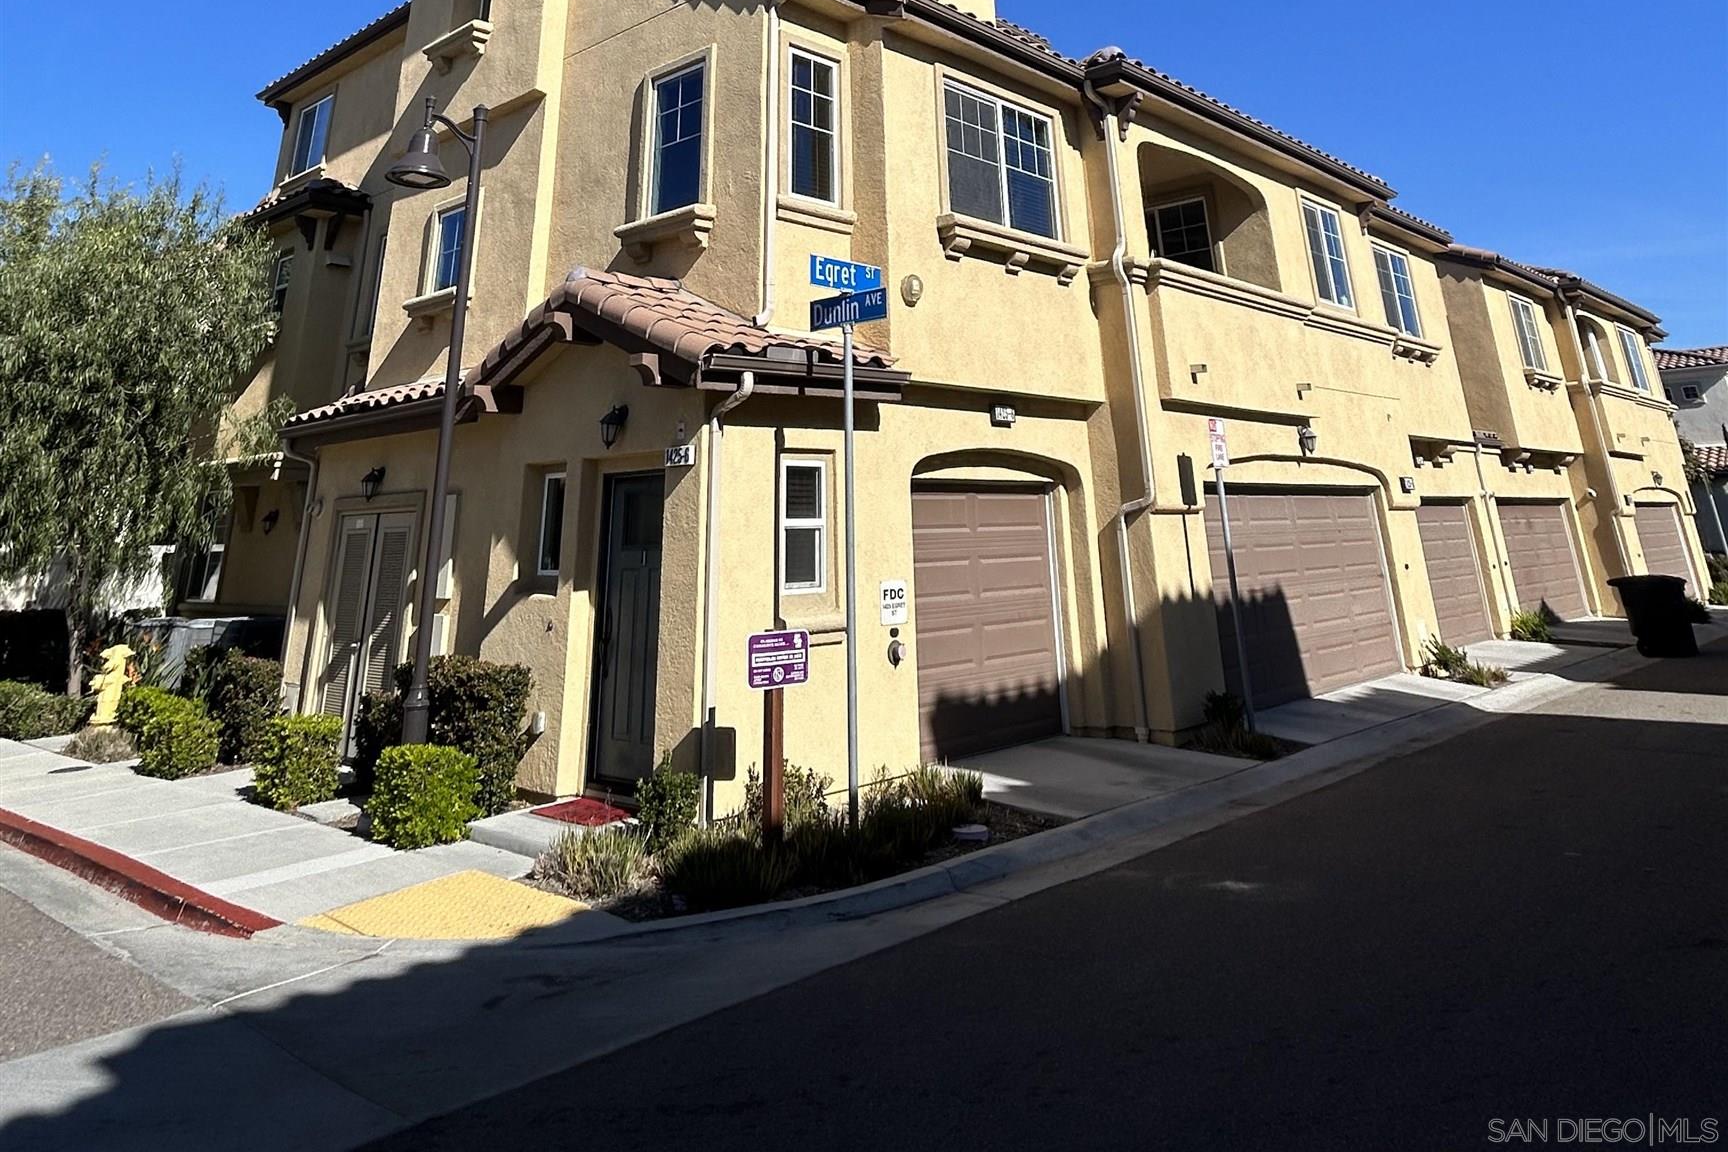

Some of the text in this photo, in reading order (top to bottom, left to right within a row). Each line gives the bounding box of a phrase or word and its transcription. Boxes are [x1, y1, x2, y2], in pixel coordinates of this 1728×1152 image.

[815, 256, 876, 286] Egret ST
[813, 292, 883, 327] Dunlin AVE
[883, 587, 905, 601] FDC
